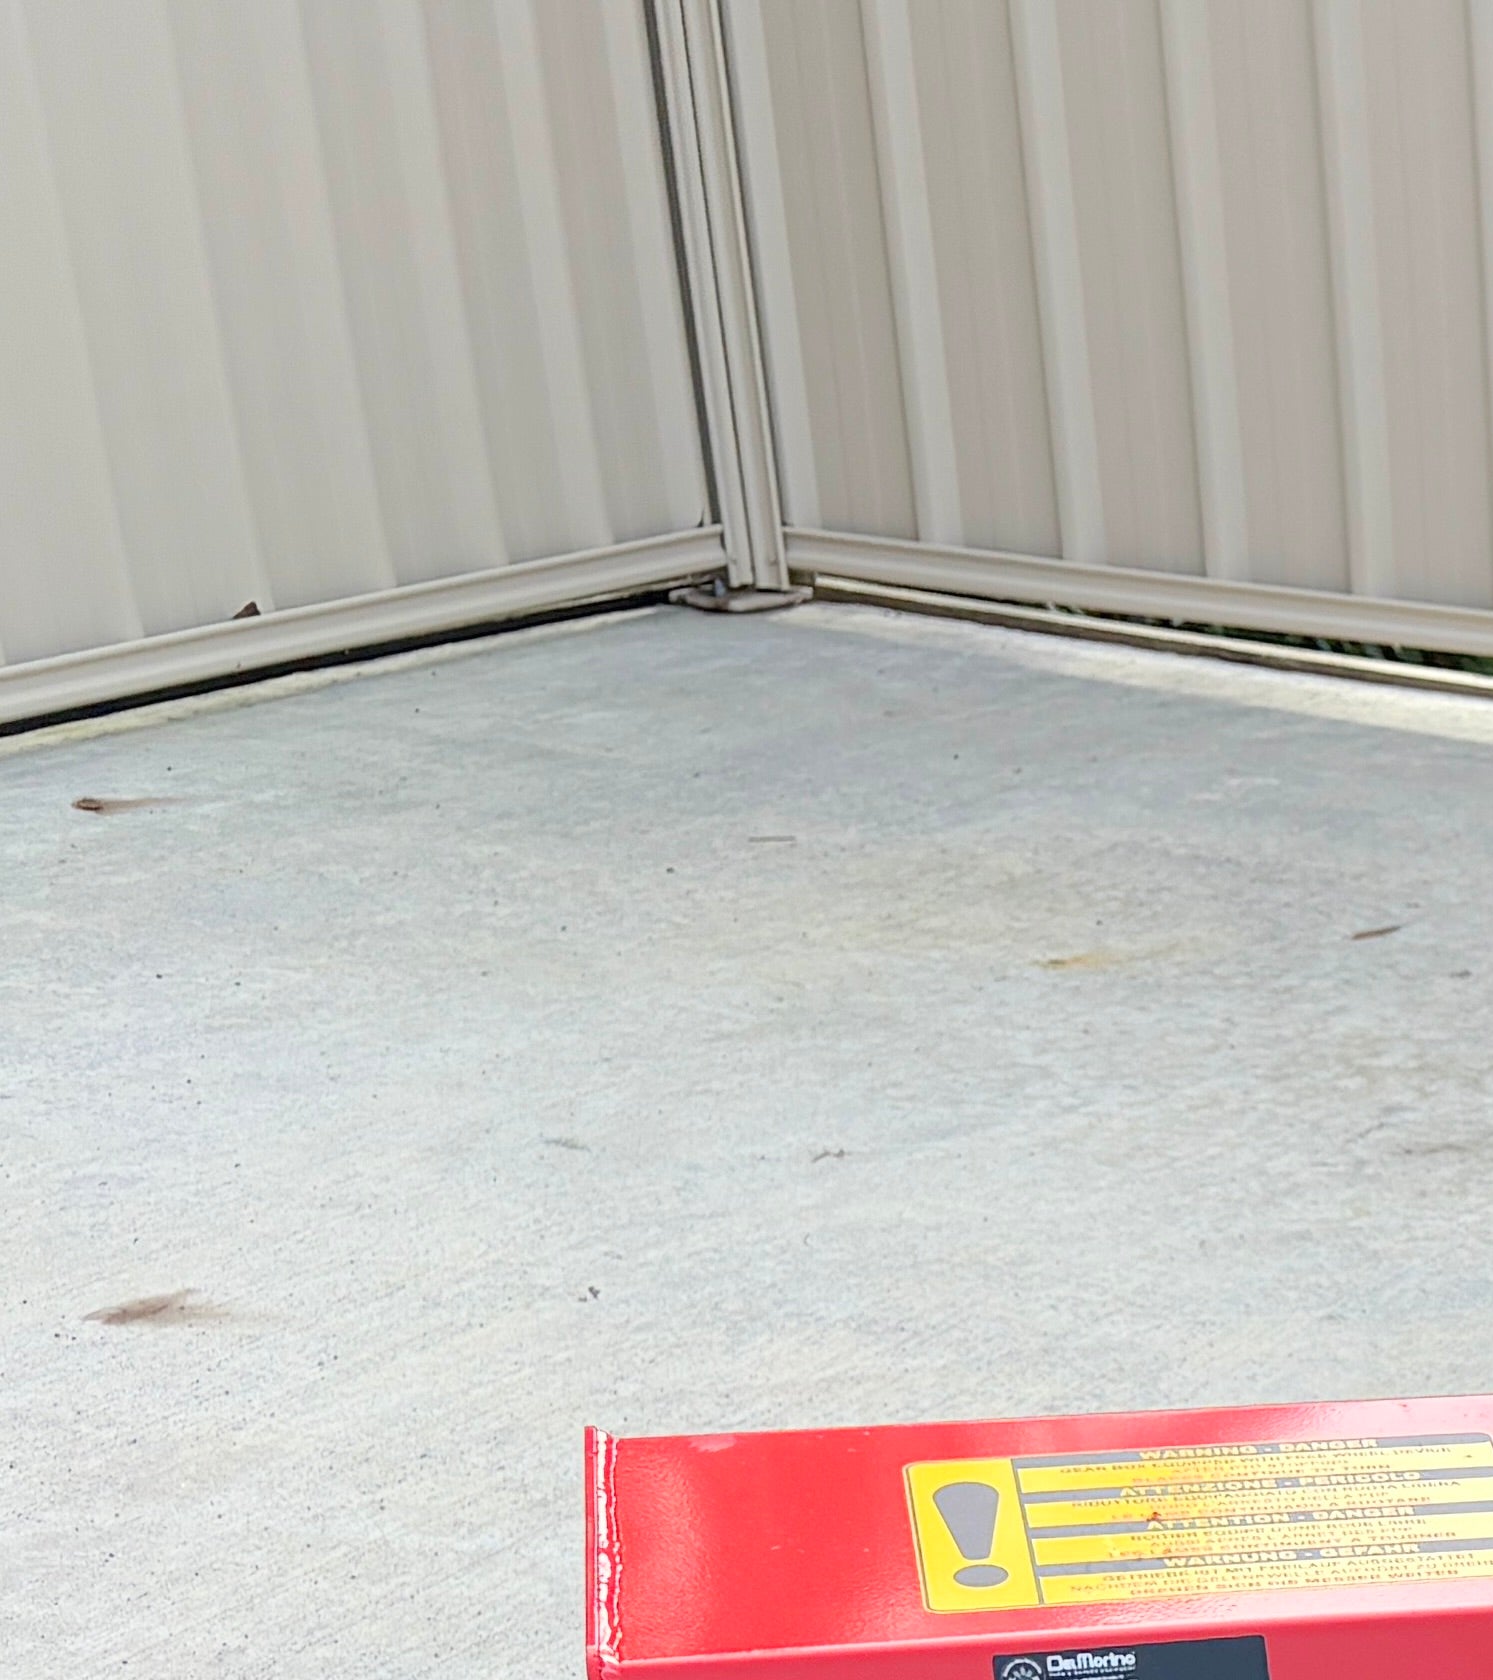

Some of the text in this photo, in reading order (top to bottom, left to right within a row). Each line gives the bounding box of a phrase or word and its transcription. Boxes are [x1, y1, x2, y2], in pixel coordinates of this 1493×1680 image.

[1139, 1445, 1258, 1460] WARNING
[1279, 1438, 1378, 1454] DANGER
[1120, 1478, 1277, 1498] ATTENZIONE
[1299, 1470, 1421, 1489] PERICOLO
[1147, 1513, 1290, 1531] ATTENTION
[1312, 1506, 1415, 1523] DANGER
[1163, 1550, 1297, 1568] WARNUNG
[1319, 1544, 1420, 1559] GEFAHR
